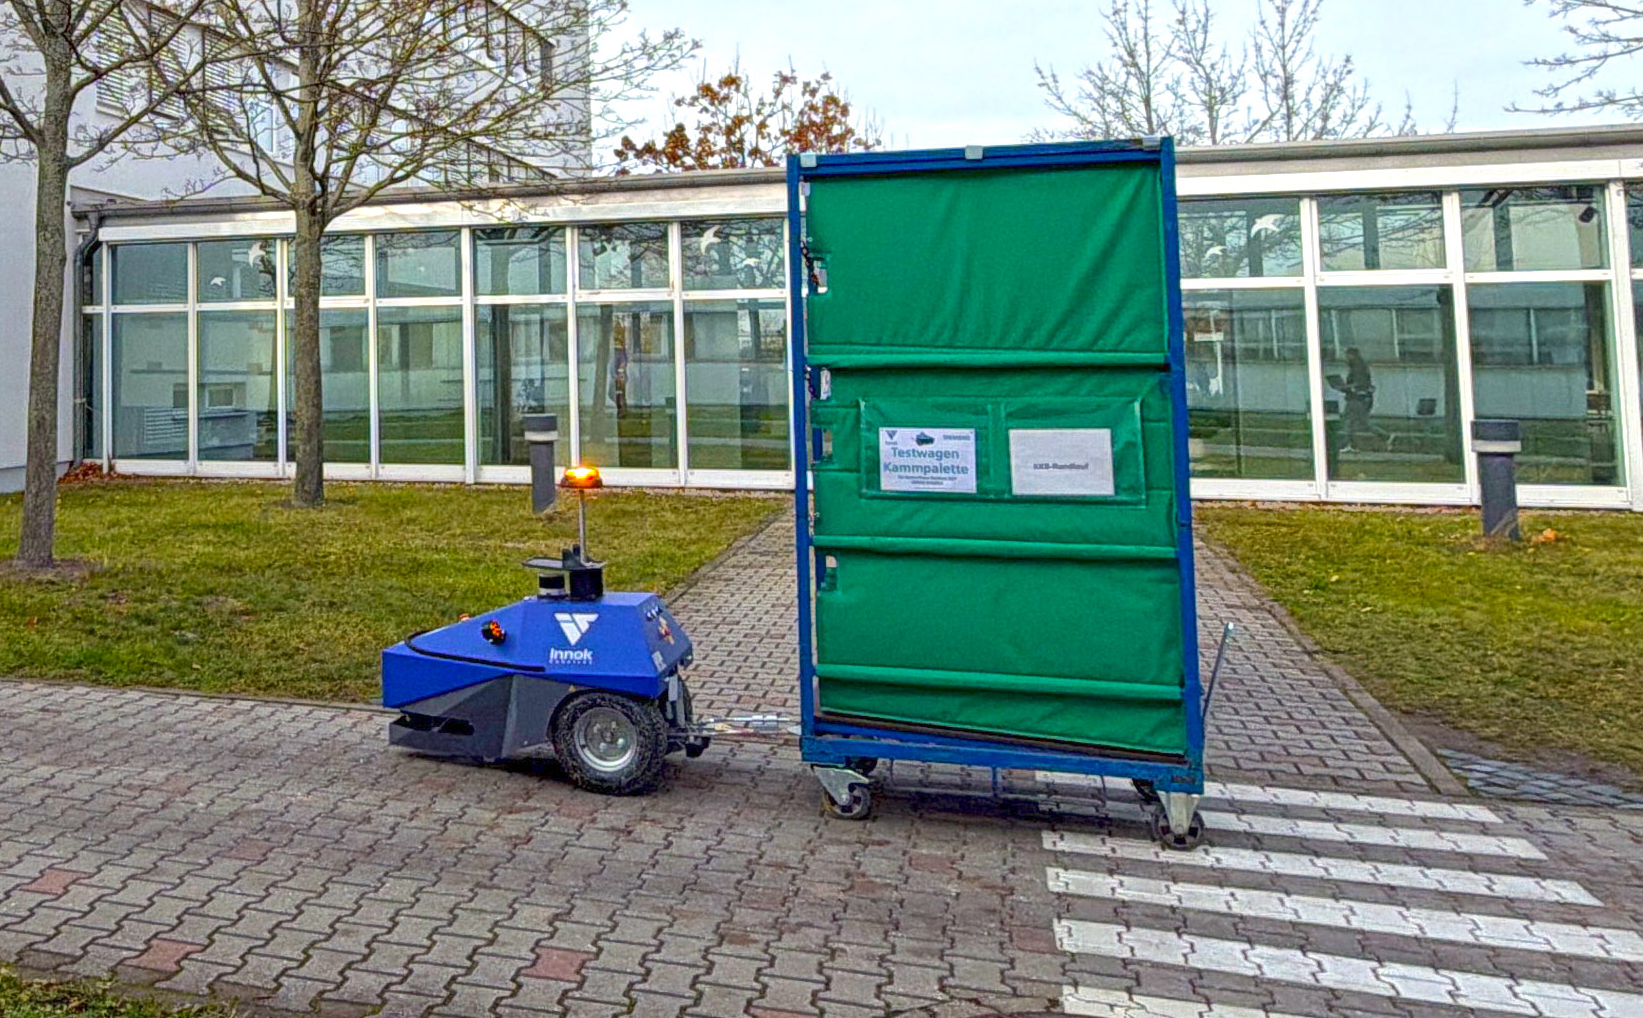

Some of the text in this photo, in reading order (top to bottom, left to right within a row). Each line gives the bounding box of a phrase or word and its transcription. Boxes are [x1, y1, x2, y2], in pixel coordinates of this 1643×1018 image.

[891, 447, 960, 461] Testwagen
[883, 462, 969, 475] Kammpalette
[550, 647, 593, 660] Innok
